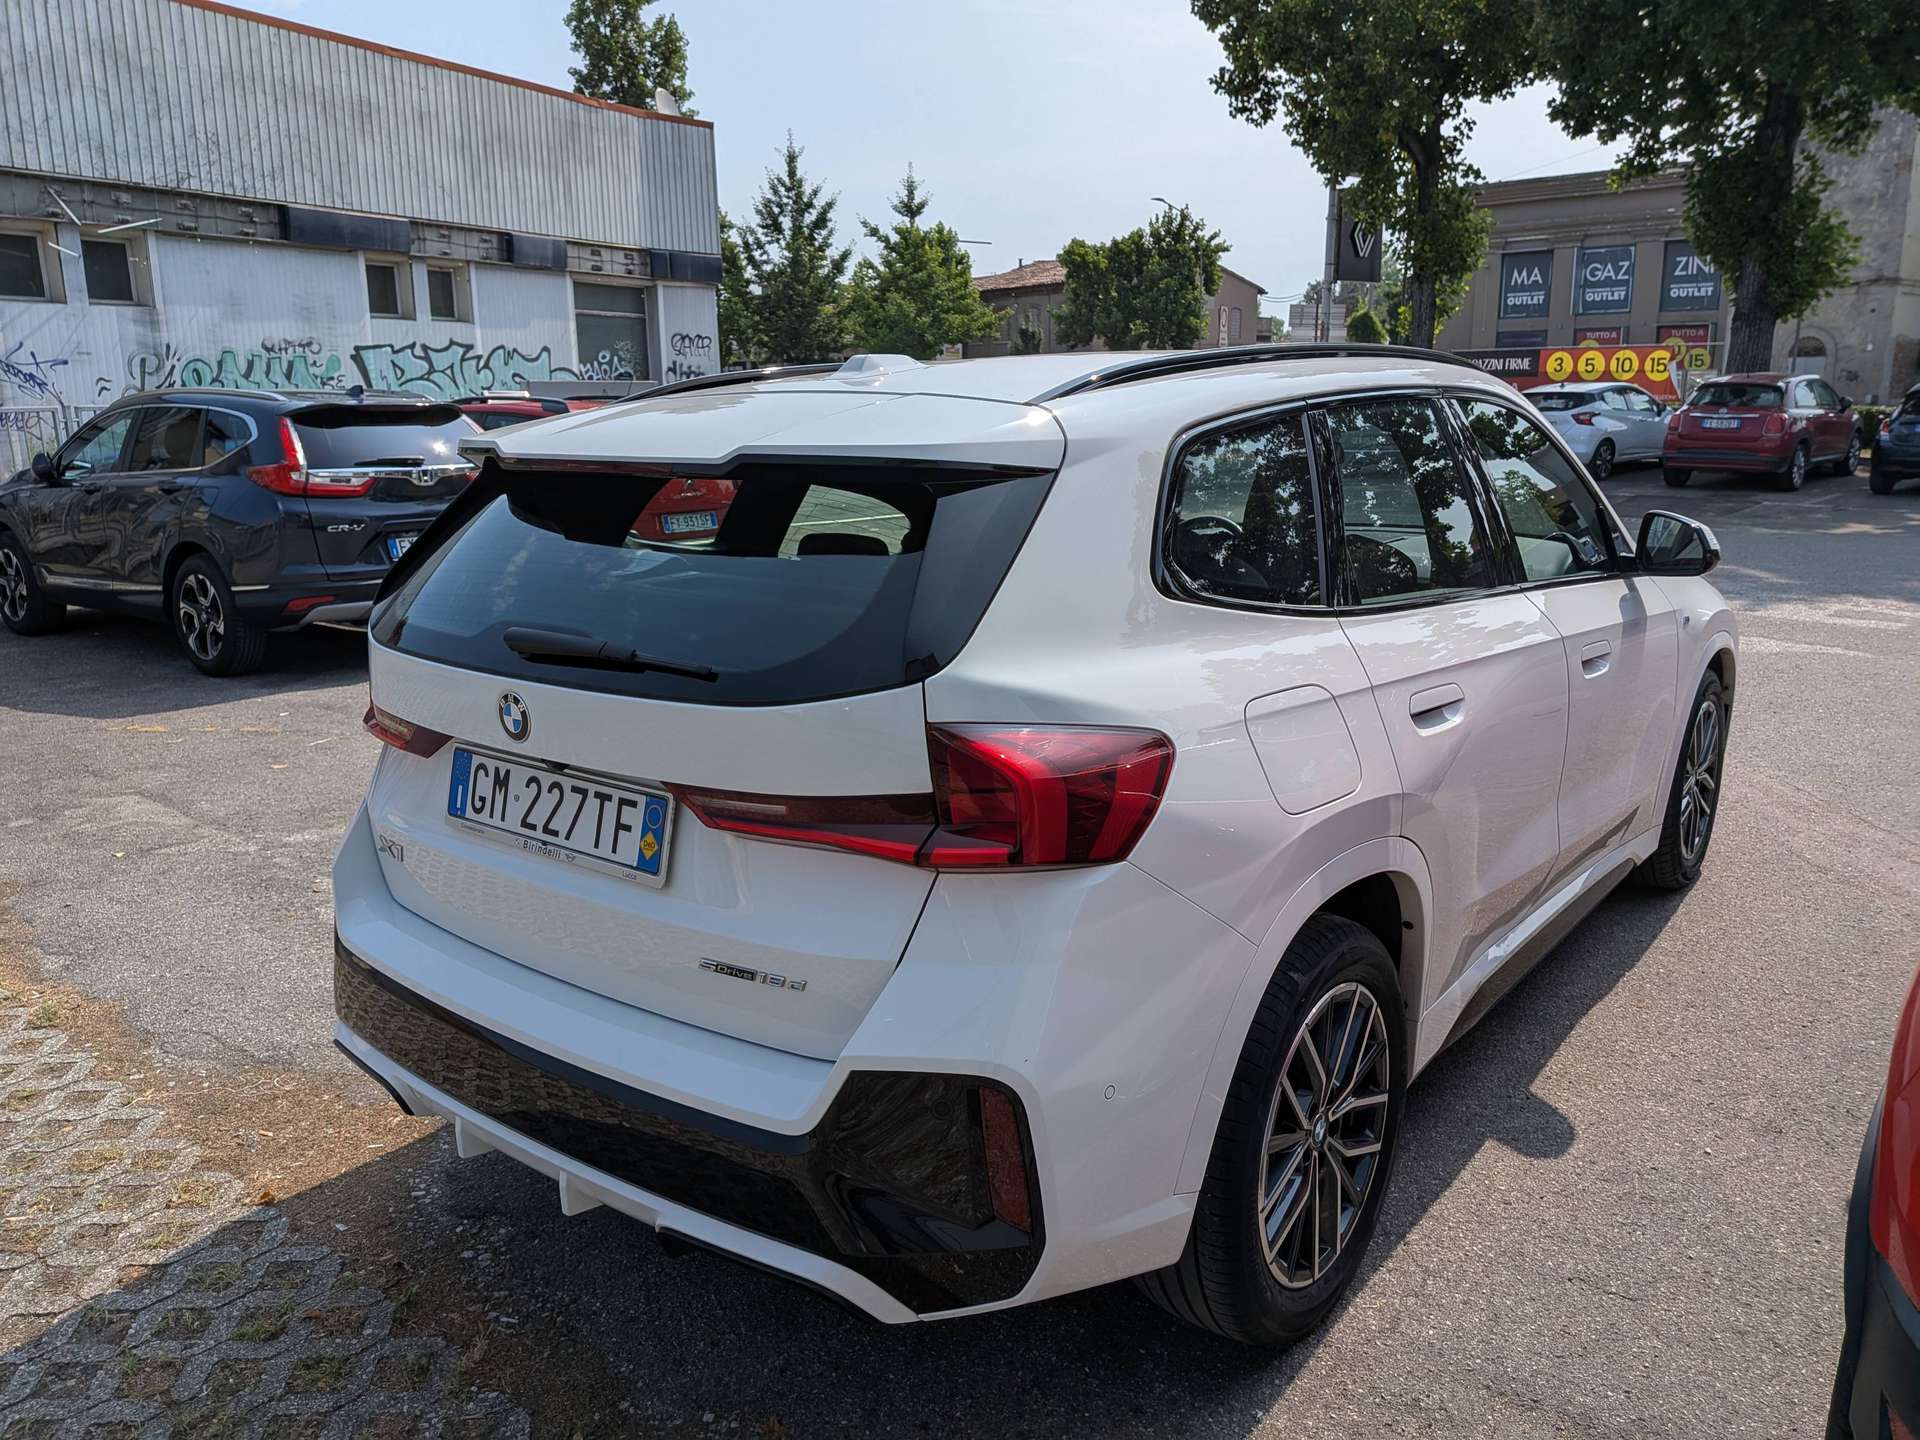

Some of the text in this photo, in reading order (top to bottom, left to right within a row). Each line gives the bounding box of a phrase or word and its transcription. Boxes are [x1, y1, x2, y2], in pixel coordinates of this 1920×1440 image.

[1510, 267, 1543, 286] MA
[1586, 261, 1630, 282] GAZ
[1585, 291, 1627, 302] OUTLET
[1670, 286, 1714, 298] OUTLET
[1506, 295, 1545, 306] OUTLET
[1586, 331, 1617, 339] TUTTO A
[1671, 328, 1704, 337] TUTTO A
[1505, 357, 1532, 371] FIRME
[1553, 356, 1564, 373] 3
[1584, 357, 1595, 373] 5
[1615, 356, 1633, 373] 10
[1650, 357, 1668, 373] 15
[1688, 353, 1705, 368] 15
[327, 523, 366, 532] CR-V
[519, 775, 639, 855] 227TF
[522, 839, 562, 861] Birindelli
